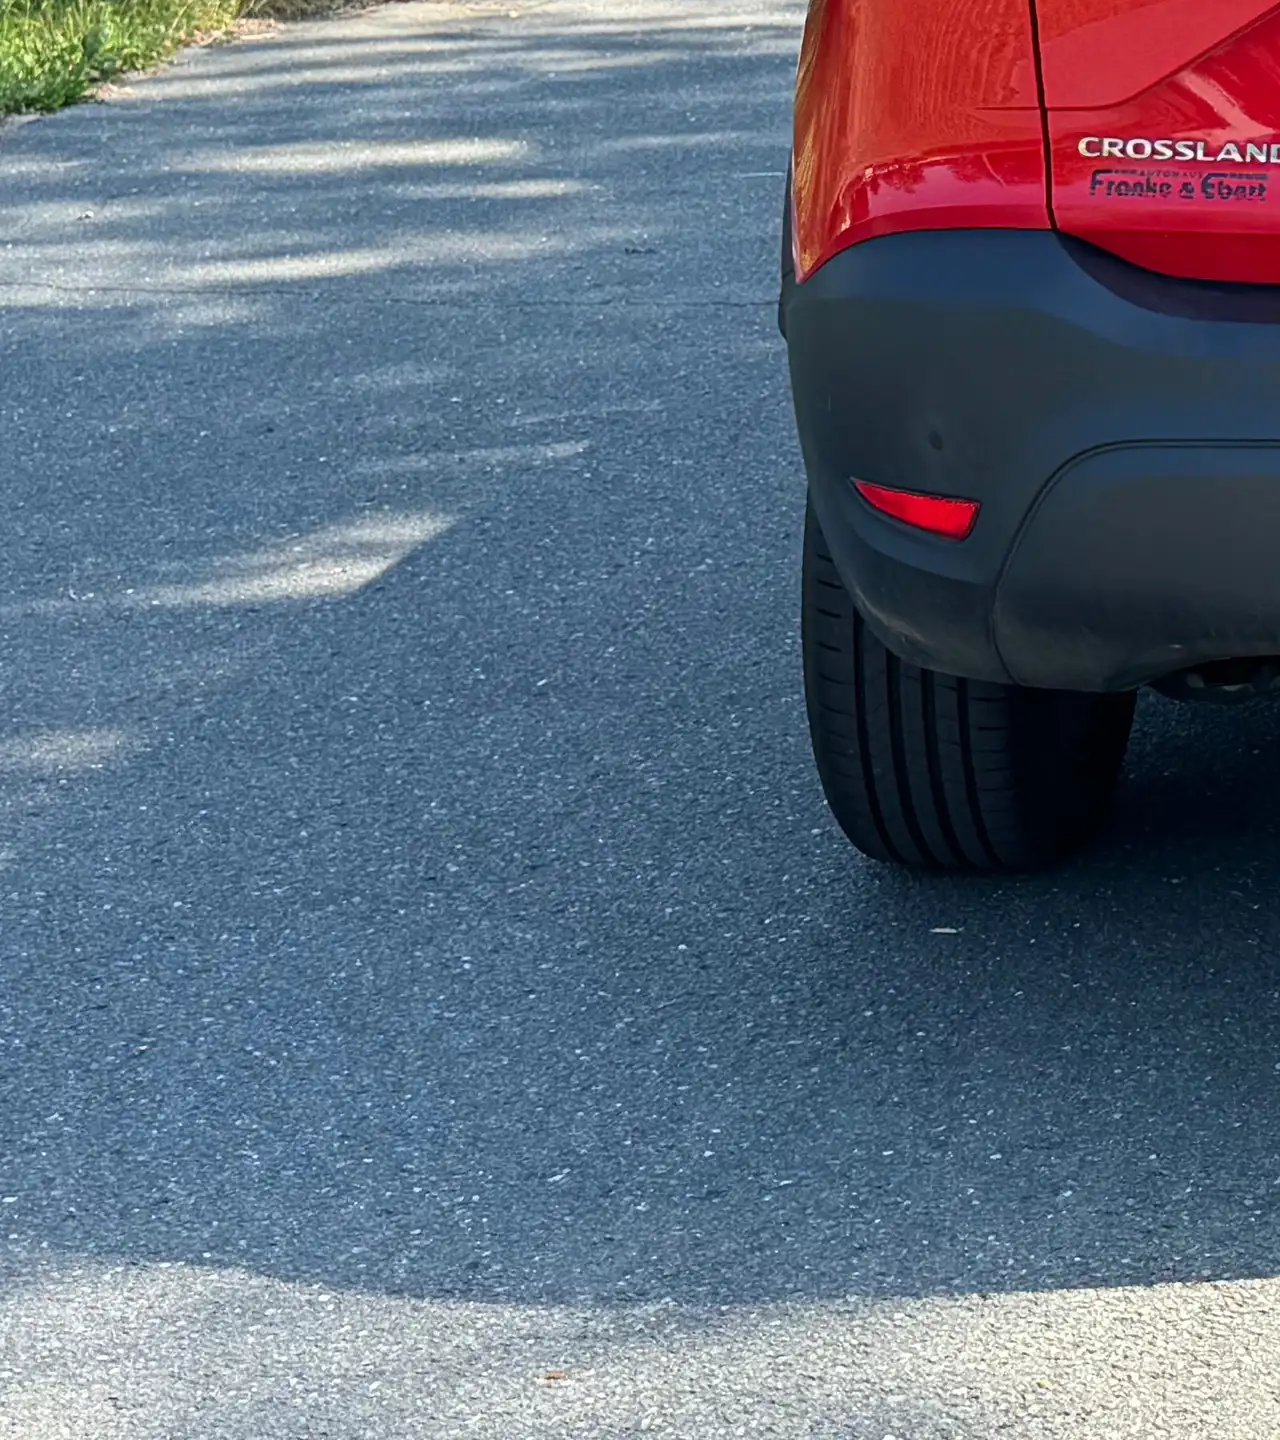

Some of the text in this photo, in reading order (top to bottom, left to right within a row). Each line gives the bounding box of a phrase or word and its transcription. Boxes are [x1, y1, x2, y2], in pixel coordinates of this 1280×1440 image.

[1089, 169, 1268, 201] Franke & Ebert
